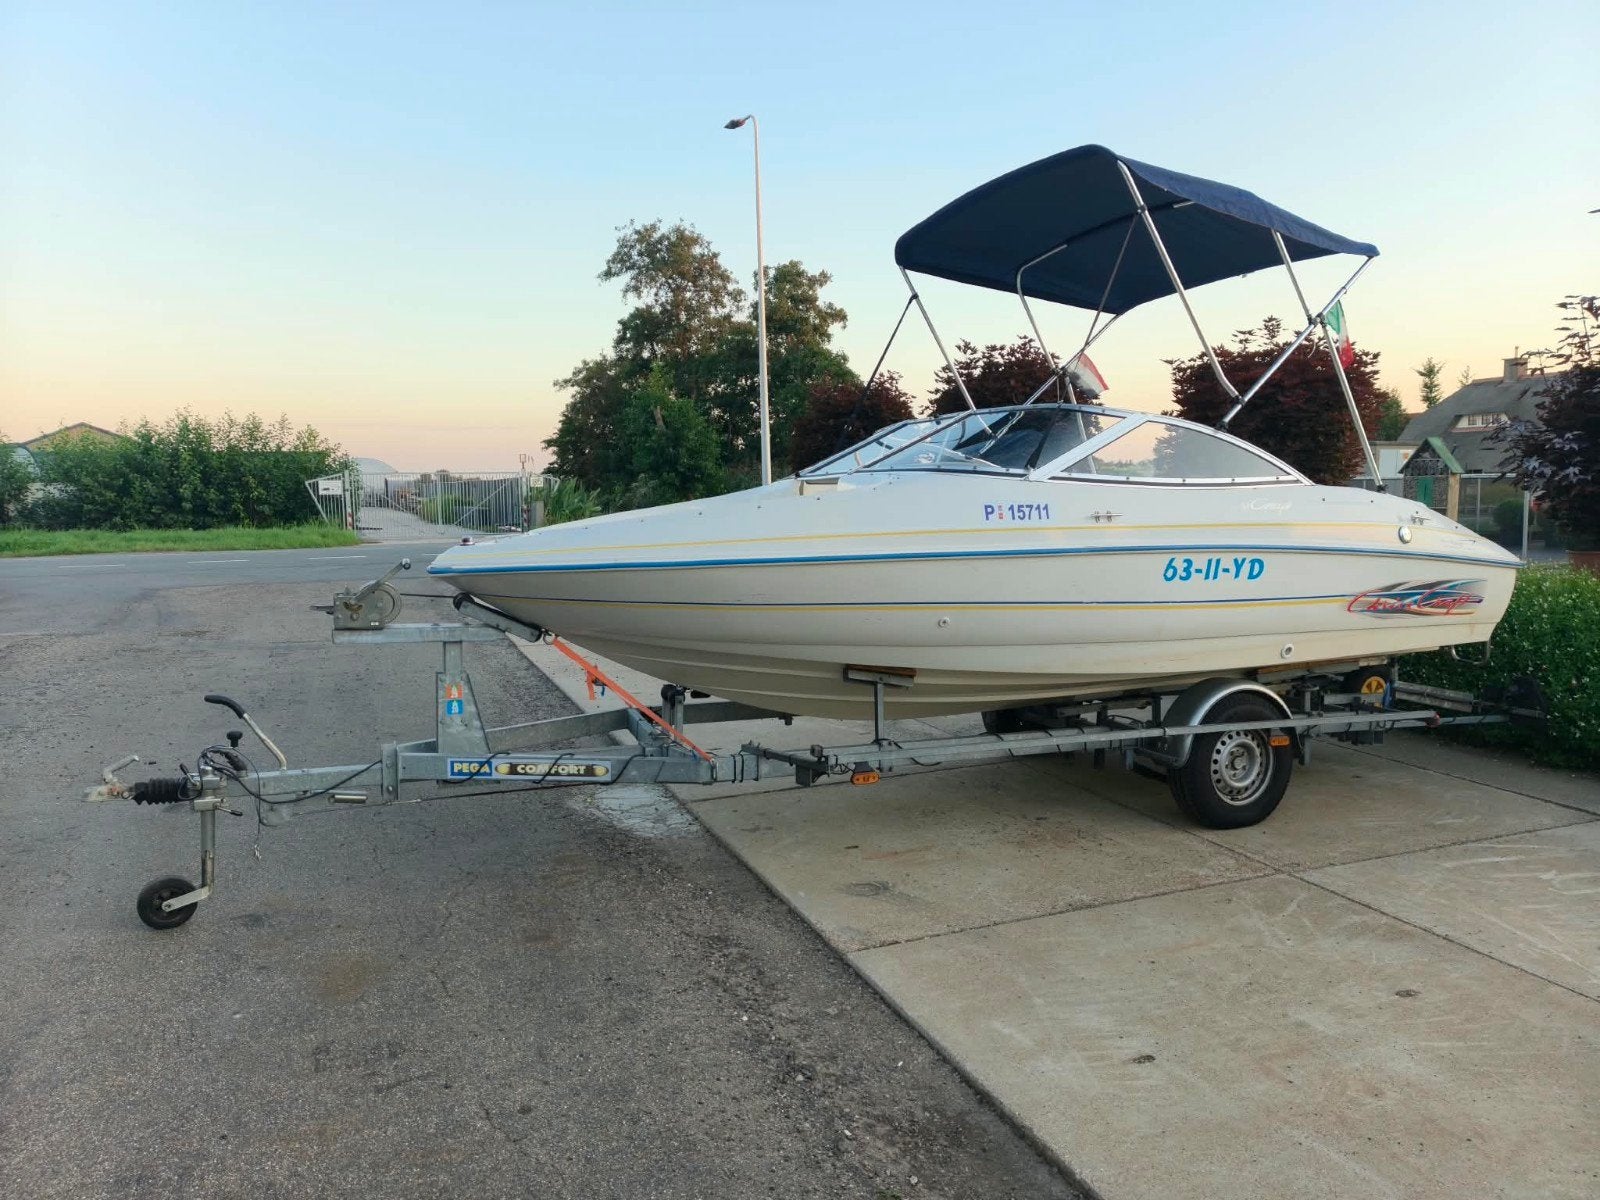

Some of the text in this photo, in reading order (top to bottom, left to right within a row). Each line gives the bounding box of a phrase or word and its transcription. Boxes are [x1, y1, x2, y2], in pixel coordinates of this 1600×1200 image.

[984, 504, 995, 521] P
[1008, 503, 1050, 521] 15711
[453, 762, 491, 774] PEGA
